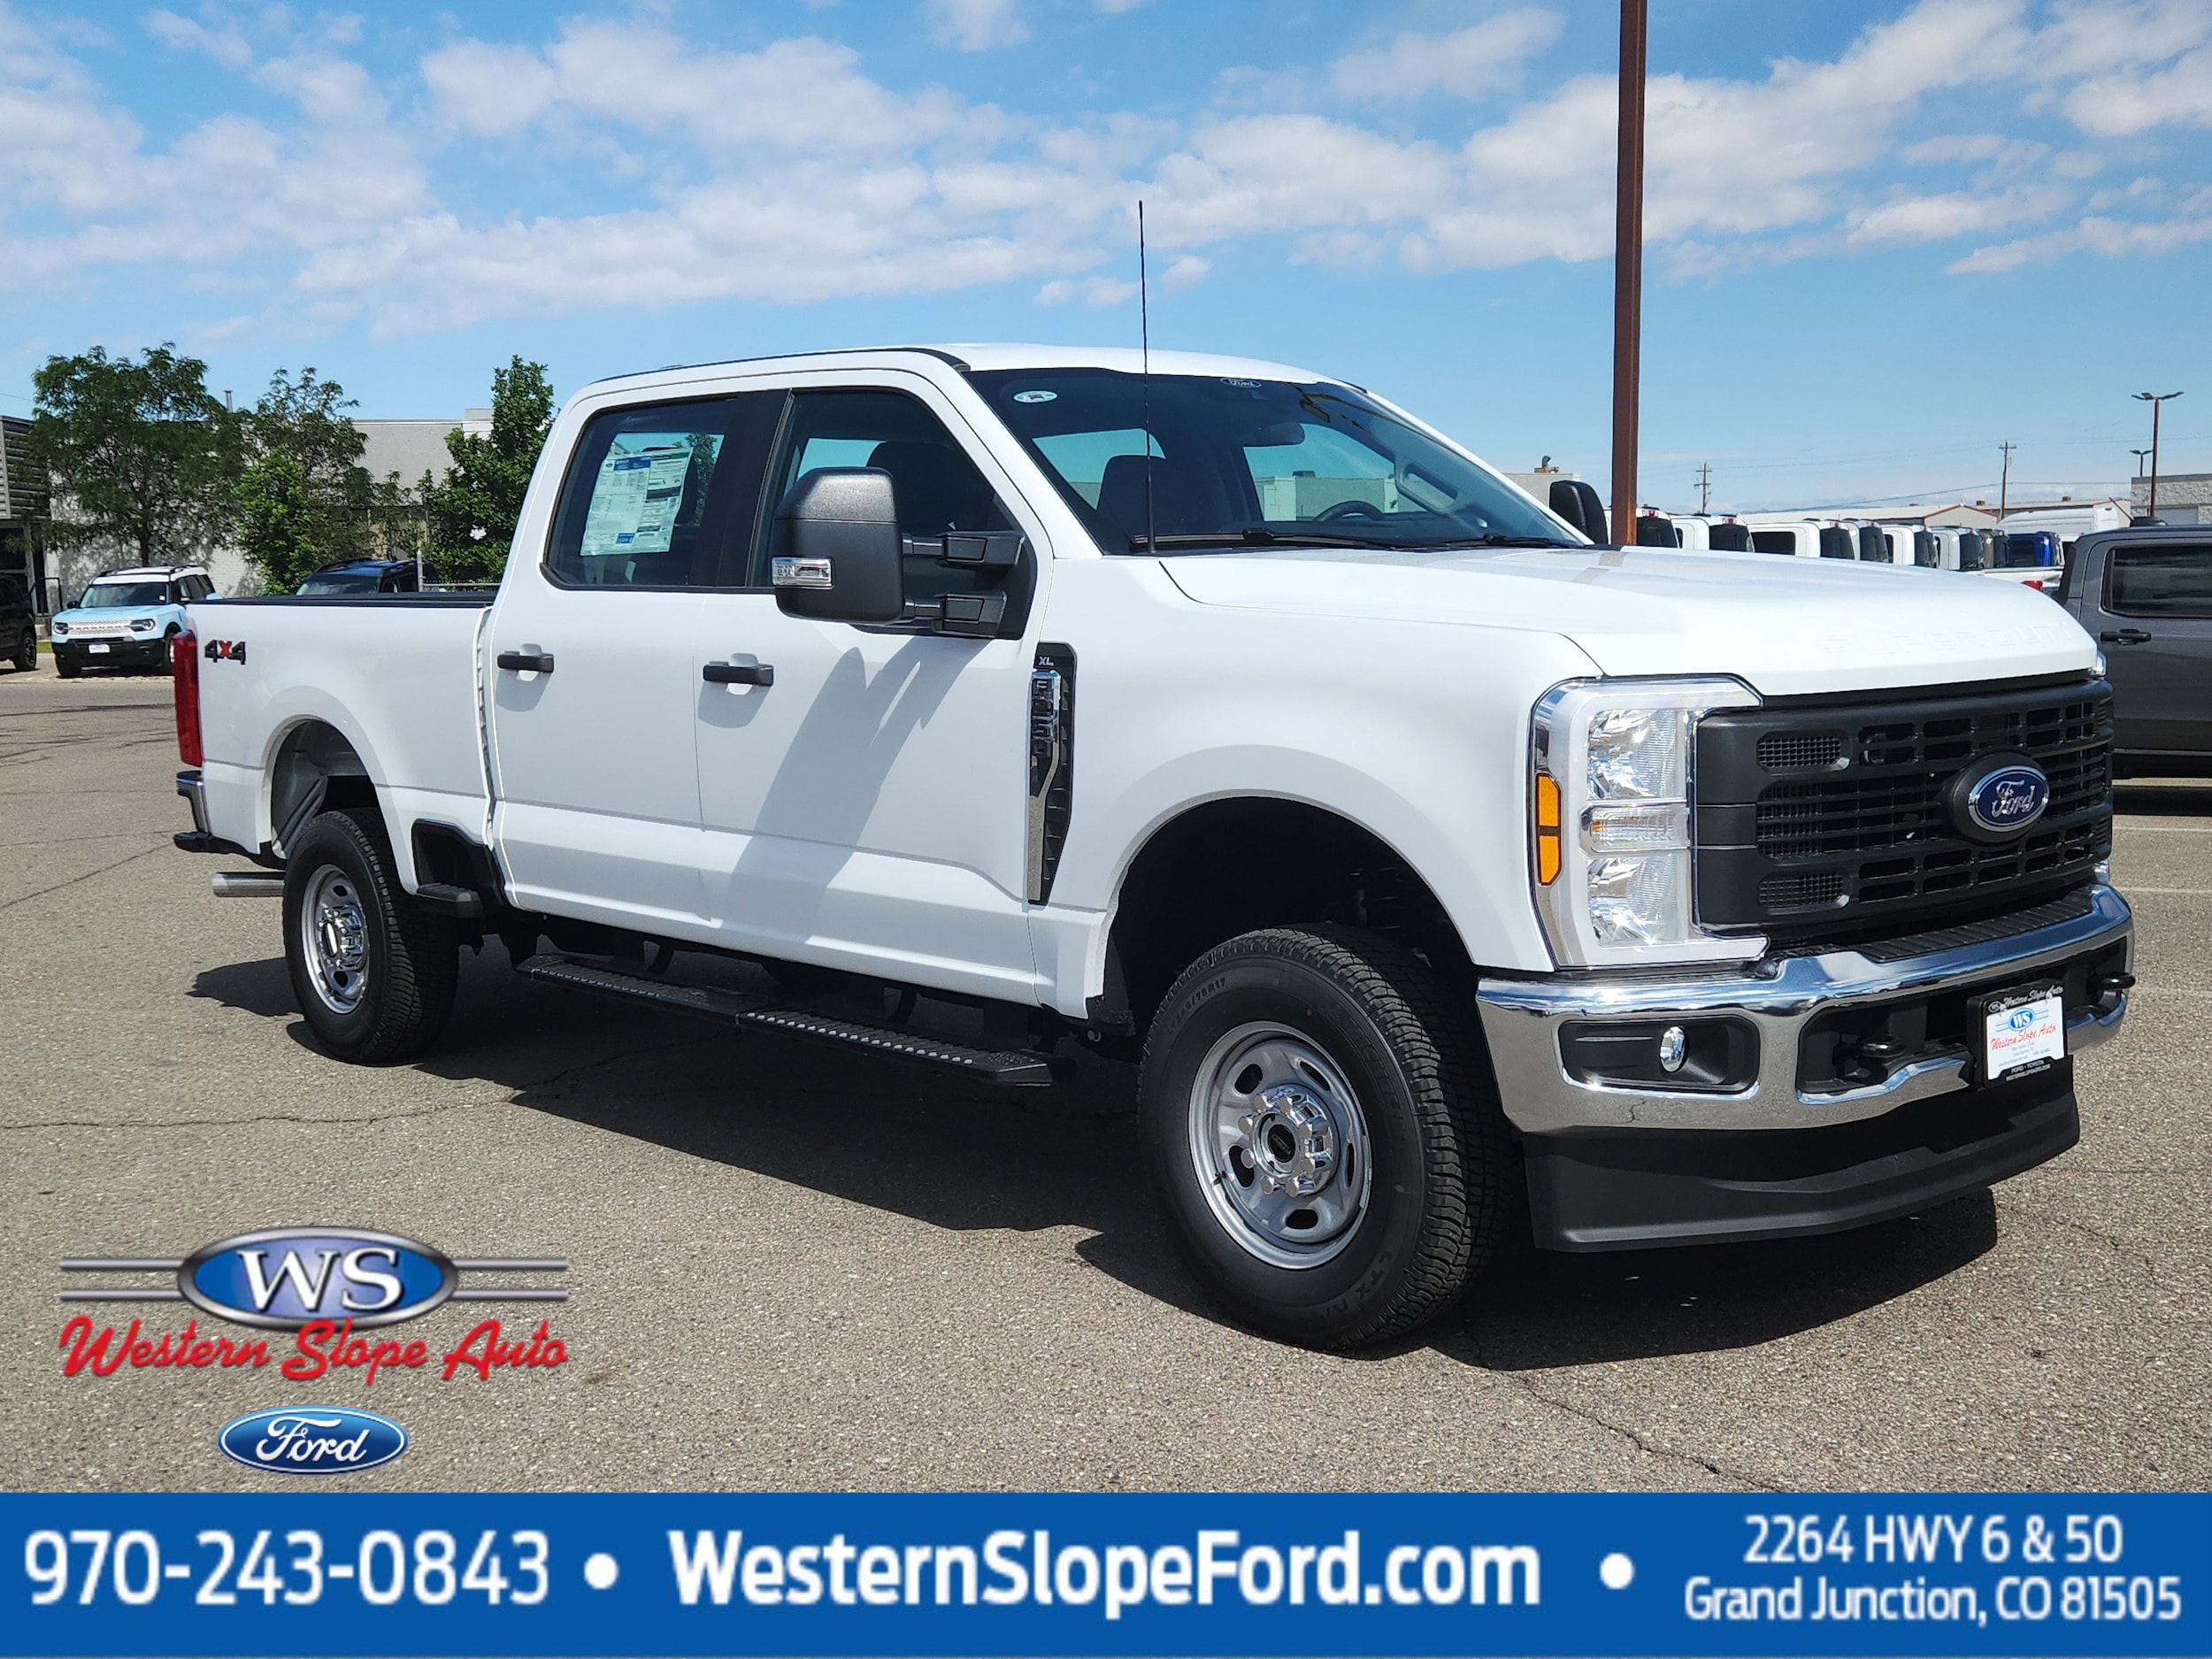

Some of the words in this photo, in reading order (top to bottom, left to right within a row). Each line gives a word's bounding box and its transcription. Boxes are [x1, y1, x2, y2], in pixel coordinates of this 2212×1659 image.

[1038, 656, 1055, 666] XL
[1991, 779, 2036, 818] Ford
[2013, 1011, 2031, 1029] WS
[2017, 1028, 2037, 1044] Slope
[2038, 1023, 2055, 1037] Auto
